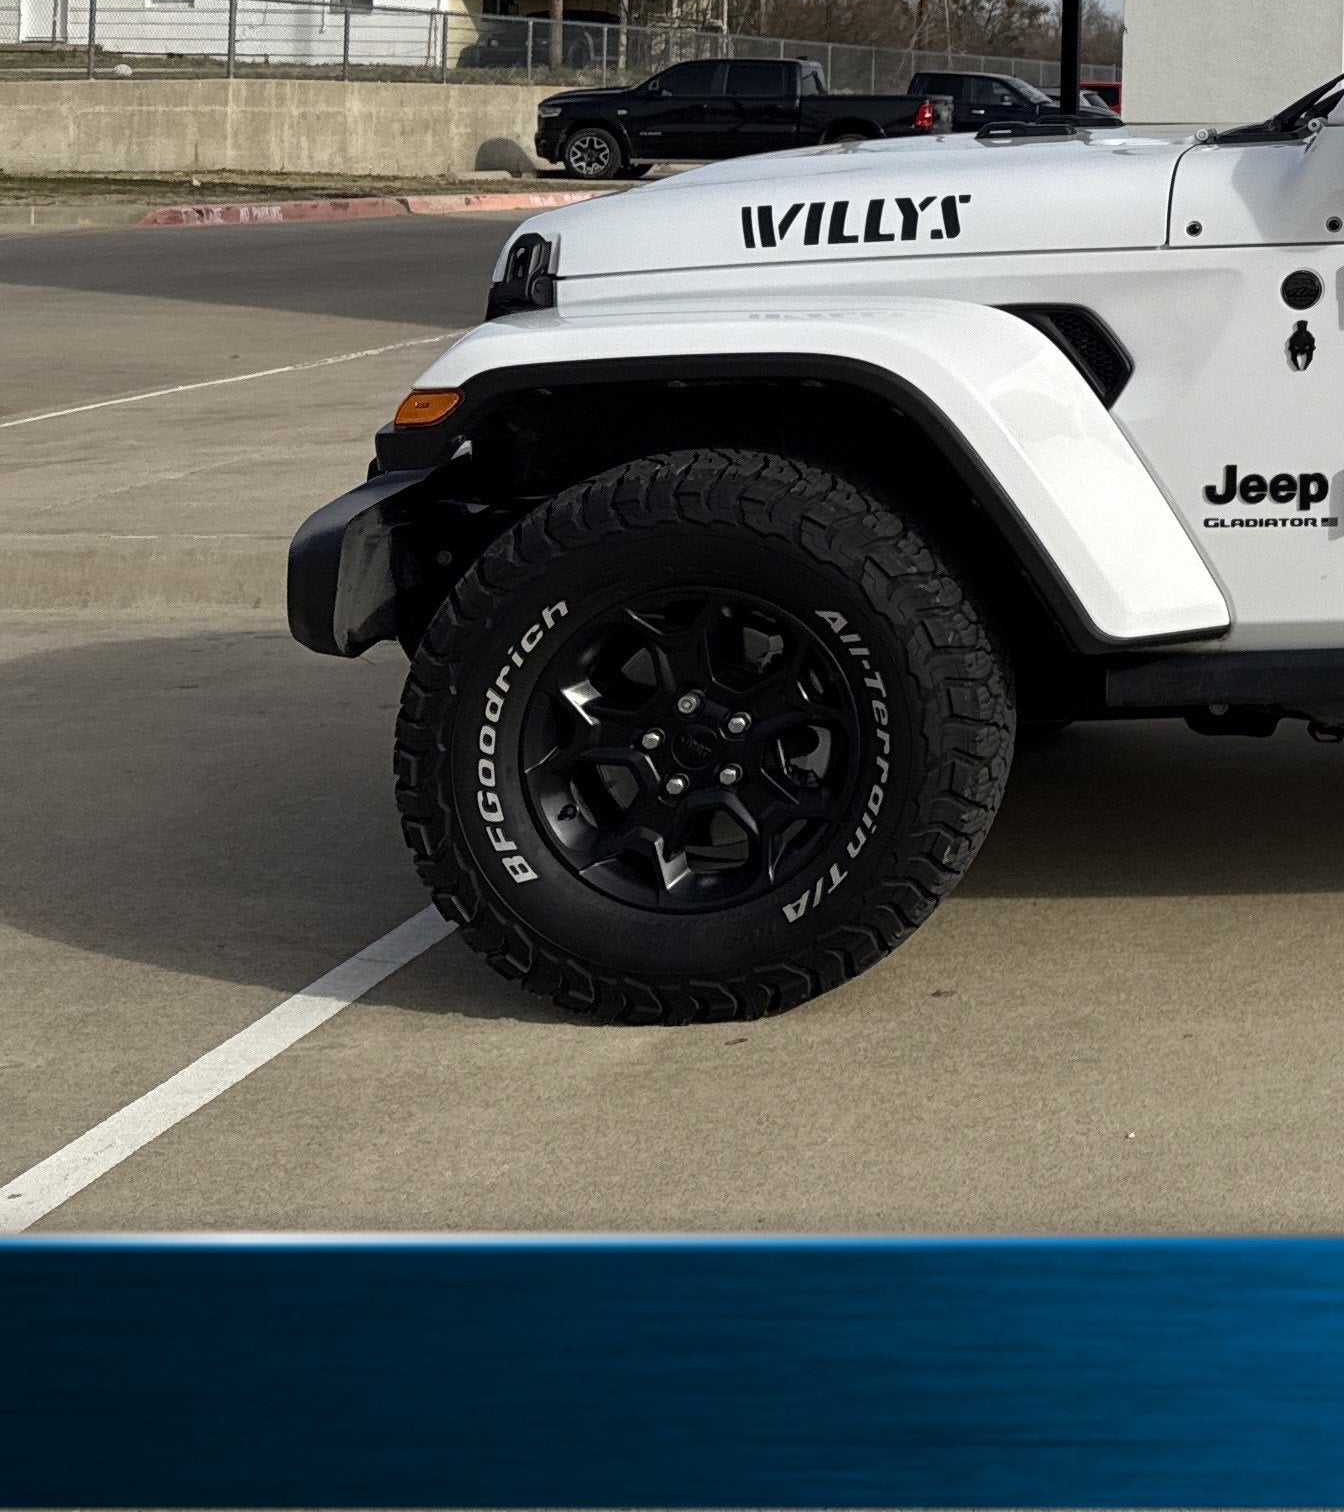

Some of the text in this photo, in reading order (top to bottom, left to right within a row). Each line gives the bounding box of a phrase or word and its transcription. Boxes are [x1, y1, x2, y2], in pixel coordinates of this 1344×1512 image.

[741, 194, 971, 249] WILLYS
[1203, 464, 1329, 511] Jeep
[1203, 517, 1318, 528] GLADIATOR
[477, 600, 569, 884] BFGoodrich
[782, 609, 891, 923] All-Terrain T/A
